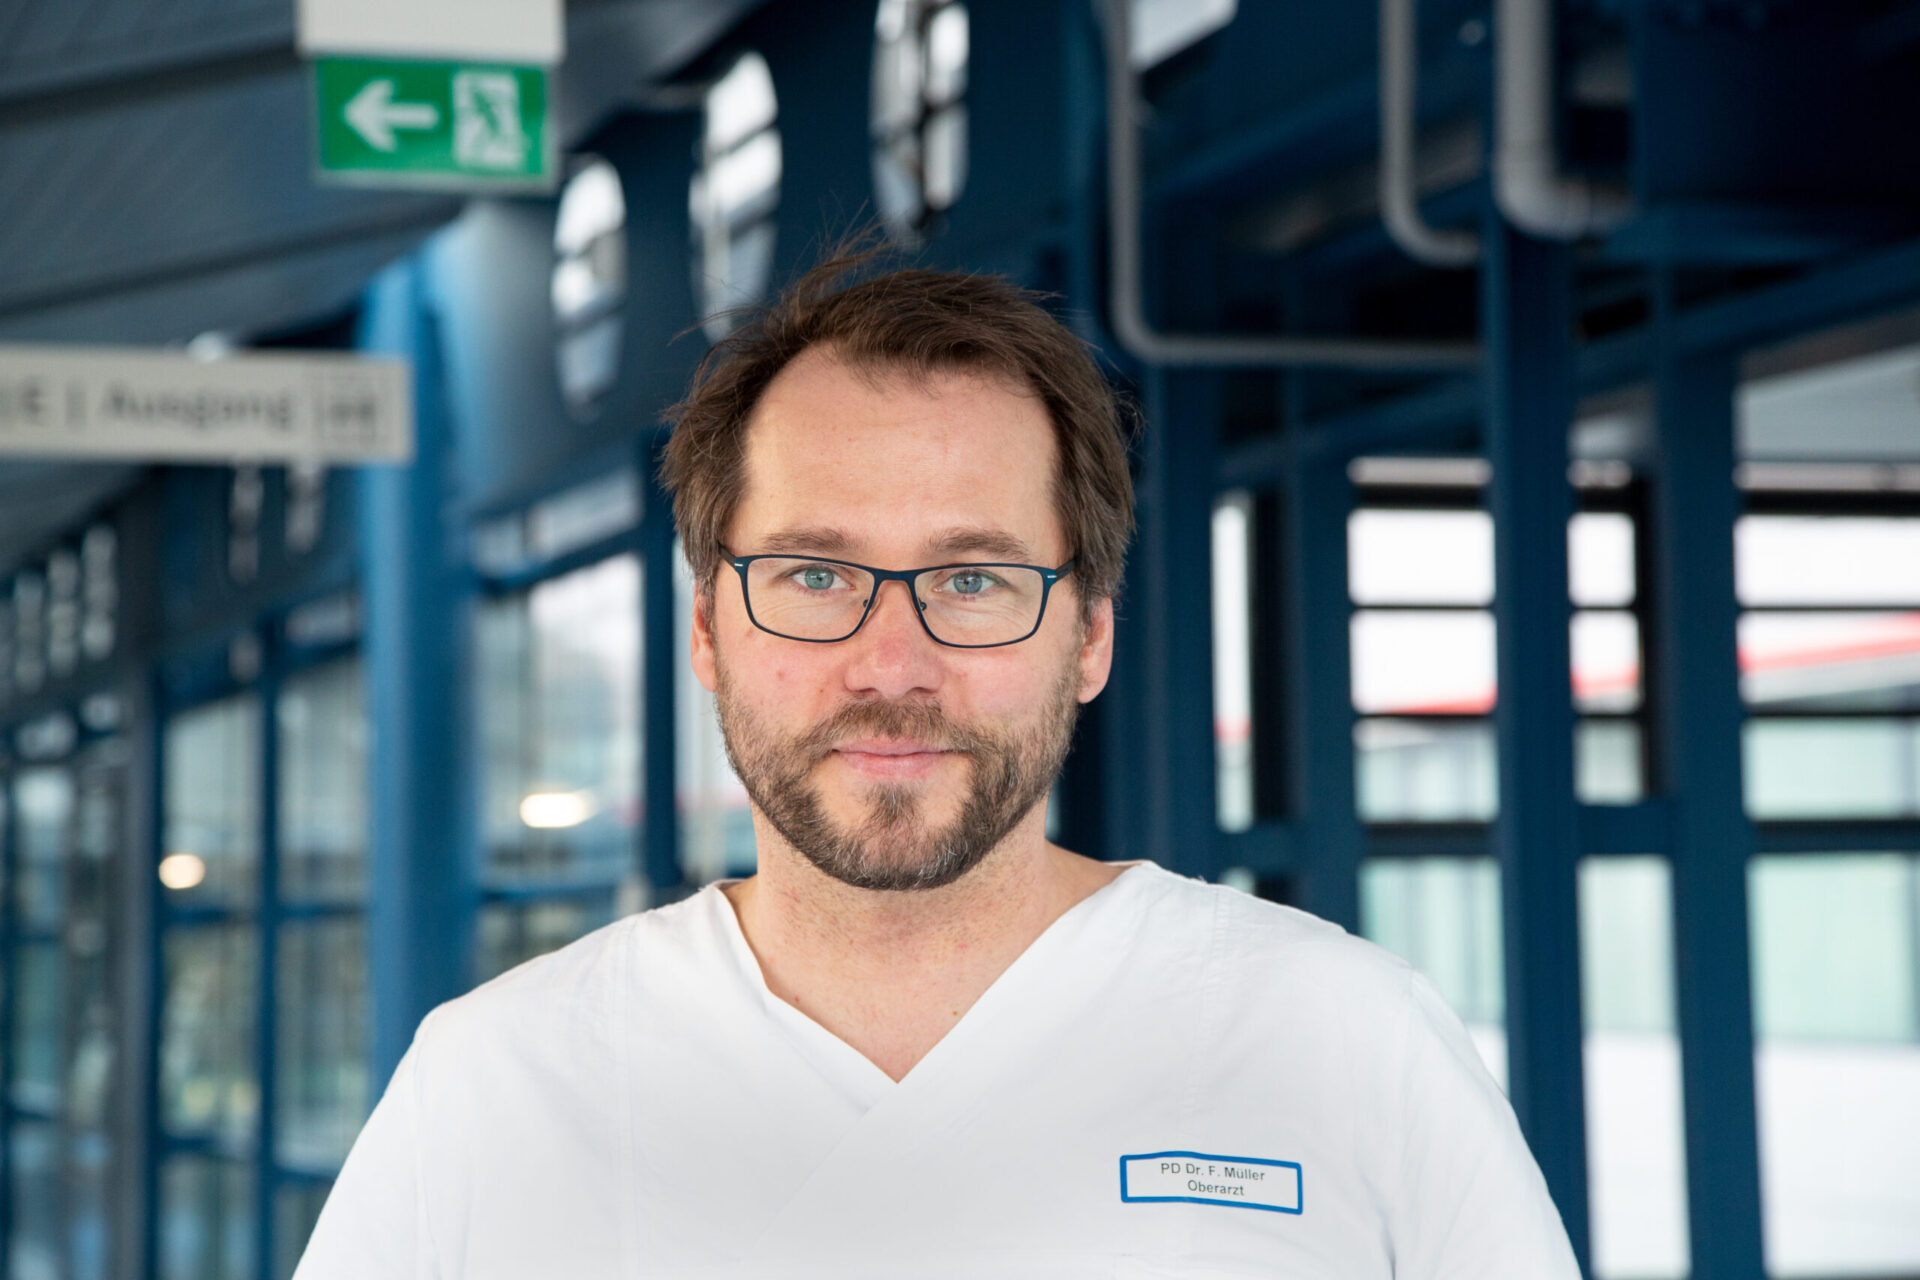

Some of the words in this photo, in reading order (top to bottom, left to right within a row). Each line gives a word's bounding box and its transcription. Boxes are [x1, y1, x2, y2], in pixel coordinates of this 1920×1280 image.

[105, 380, 292, 434] Ausgang
[1161, 1163, 1181, 1174] PD
[1186, 1163, 1204, 1176] Dr.
[1209, 1166, 1220, 1177] F.
[1224, 1167, 1265, 1181] Müller
[1187, 1180, 1245, 1196] Oberarzt
